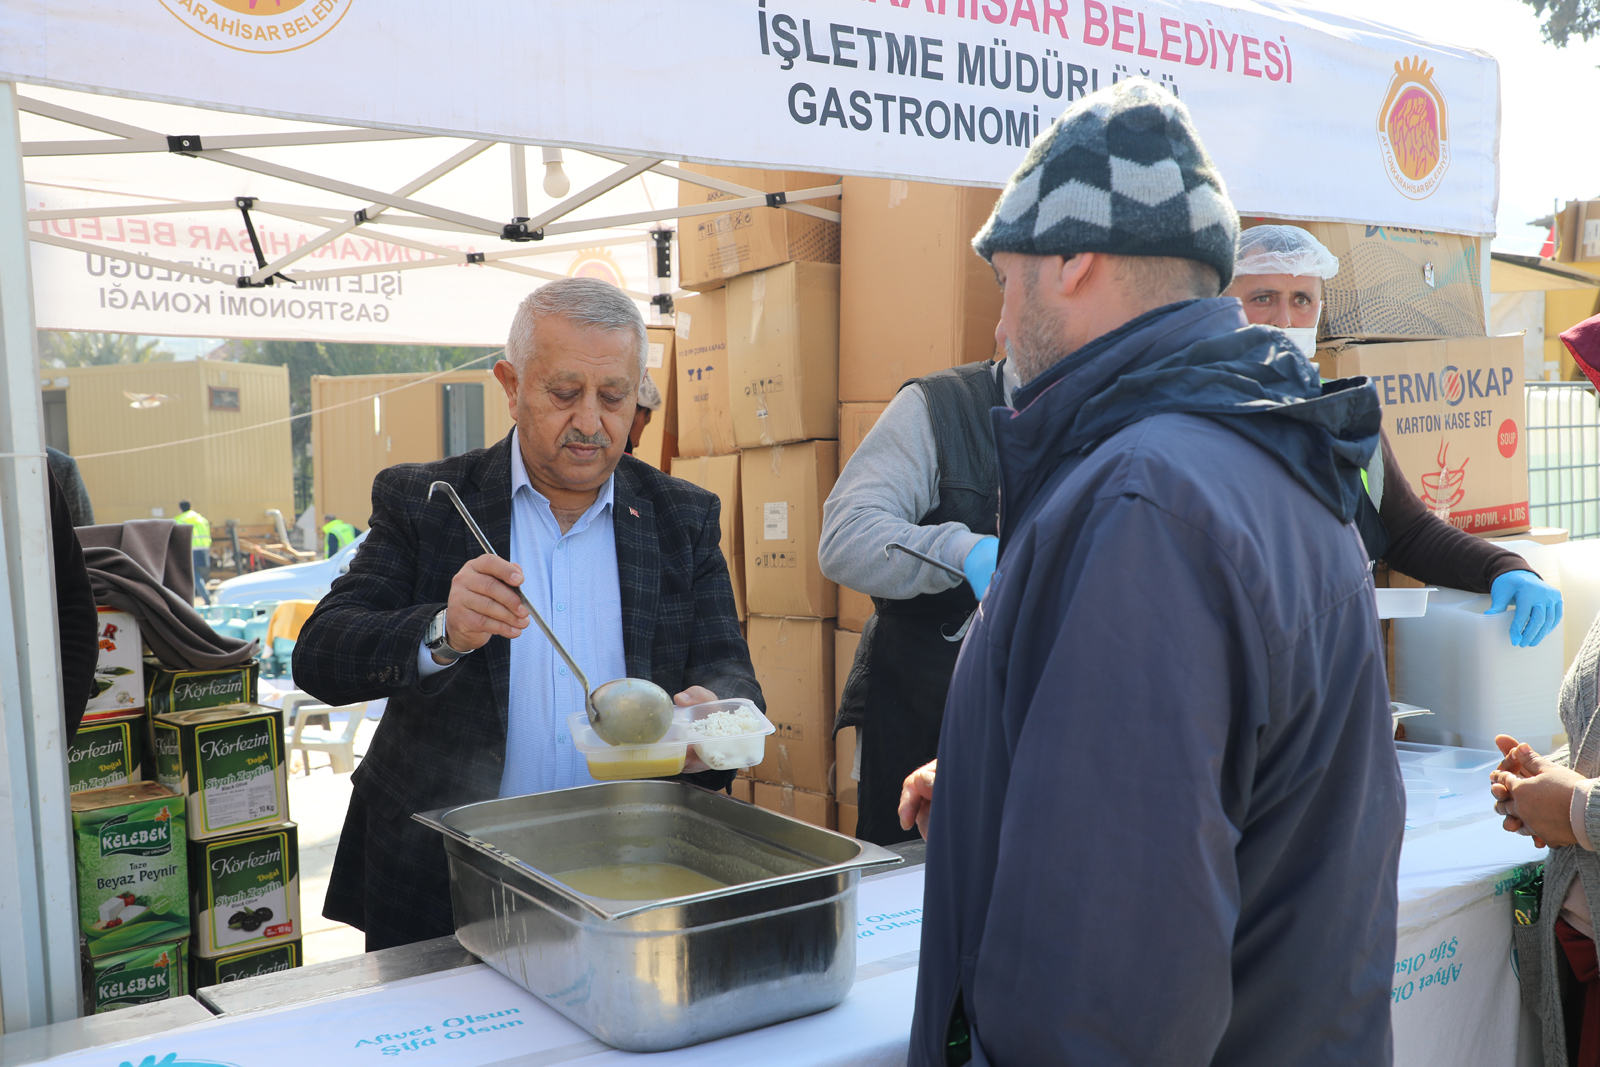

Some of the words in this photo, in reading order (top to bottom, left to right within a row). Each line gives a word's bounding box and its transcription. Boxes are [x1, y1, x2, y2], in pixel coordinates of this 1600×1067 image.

[174, 0, 281, 42] ARAHİSAR
[758, 0, 944, 81] İŞLETME
[957, 37, 1179, 102] MÜDÜR
[1083, 0, 1293, 84] BELEDİYESİ
[788, 82, 1039, 149] GASTRONOMİ
[1371, 365, 1514, 407] TERMOKAP
[1396, 412, 1441, 435] KARTON
[1444, 411, 1471, 431] KASE
[1473, 409, 1493, 428] SET
[1500, 432, 1516, 446] SOUP
[1450, 513, 1472, 530] SOUP
[1474, 510, 1500, 528] BOWL
[1509, 506, 1526, 523] LIDS
[174, 679, 243, 702] Körfezim
[200, 732, 269, 762] Körfezim
[246, 752, 269, 766] Doğal
[98, 758, 122, 772] Doğal
[205, 773, 237, 790] Siyah
[237, 765, 271, 781] Zeytin
[88, 770, 125, 789] Zeytin
[102, 826, 168, 851] KELEBEK
[129, 862, 148, 871] Taze
[211, 848, 281, 879] Körfezim
[256, 867, 280, 882] Doğal
[96, 874, 136, 891] Beyaz
[139, 864, 178, 882] Peynir
[215, 890, 247, 908] Siyah
[247, 880, 282, 899] Zeytin
[875, 917, 923, 931] Olsu
[221, 960, 289, 984] Kfezim
[1393, 953, 1426, 976] Olsu
[1418, 962, 1463, 992] Afiyet
[98, 972, 167, 1000] KELEBEK
[442, 1007, 521, 1028] Olsun
[380, 1036, 438, 1057] Şifa
[443, 1018, 525, 1040] Olsun
